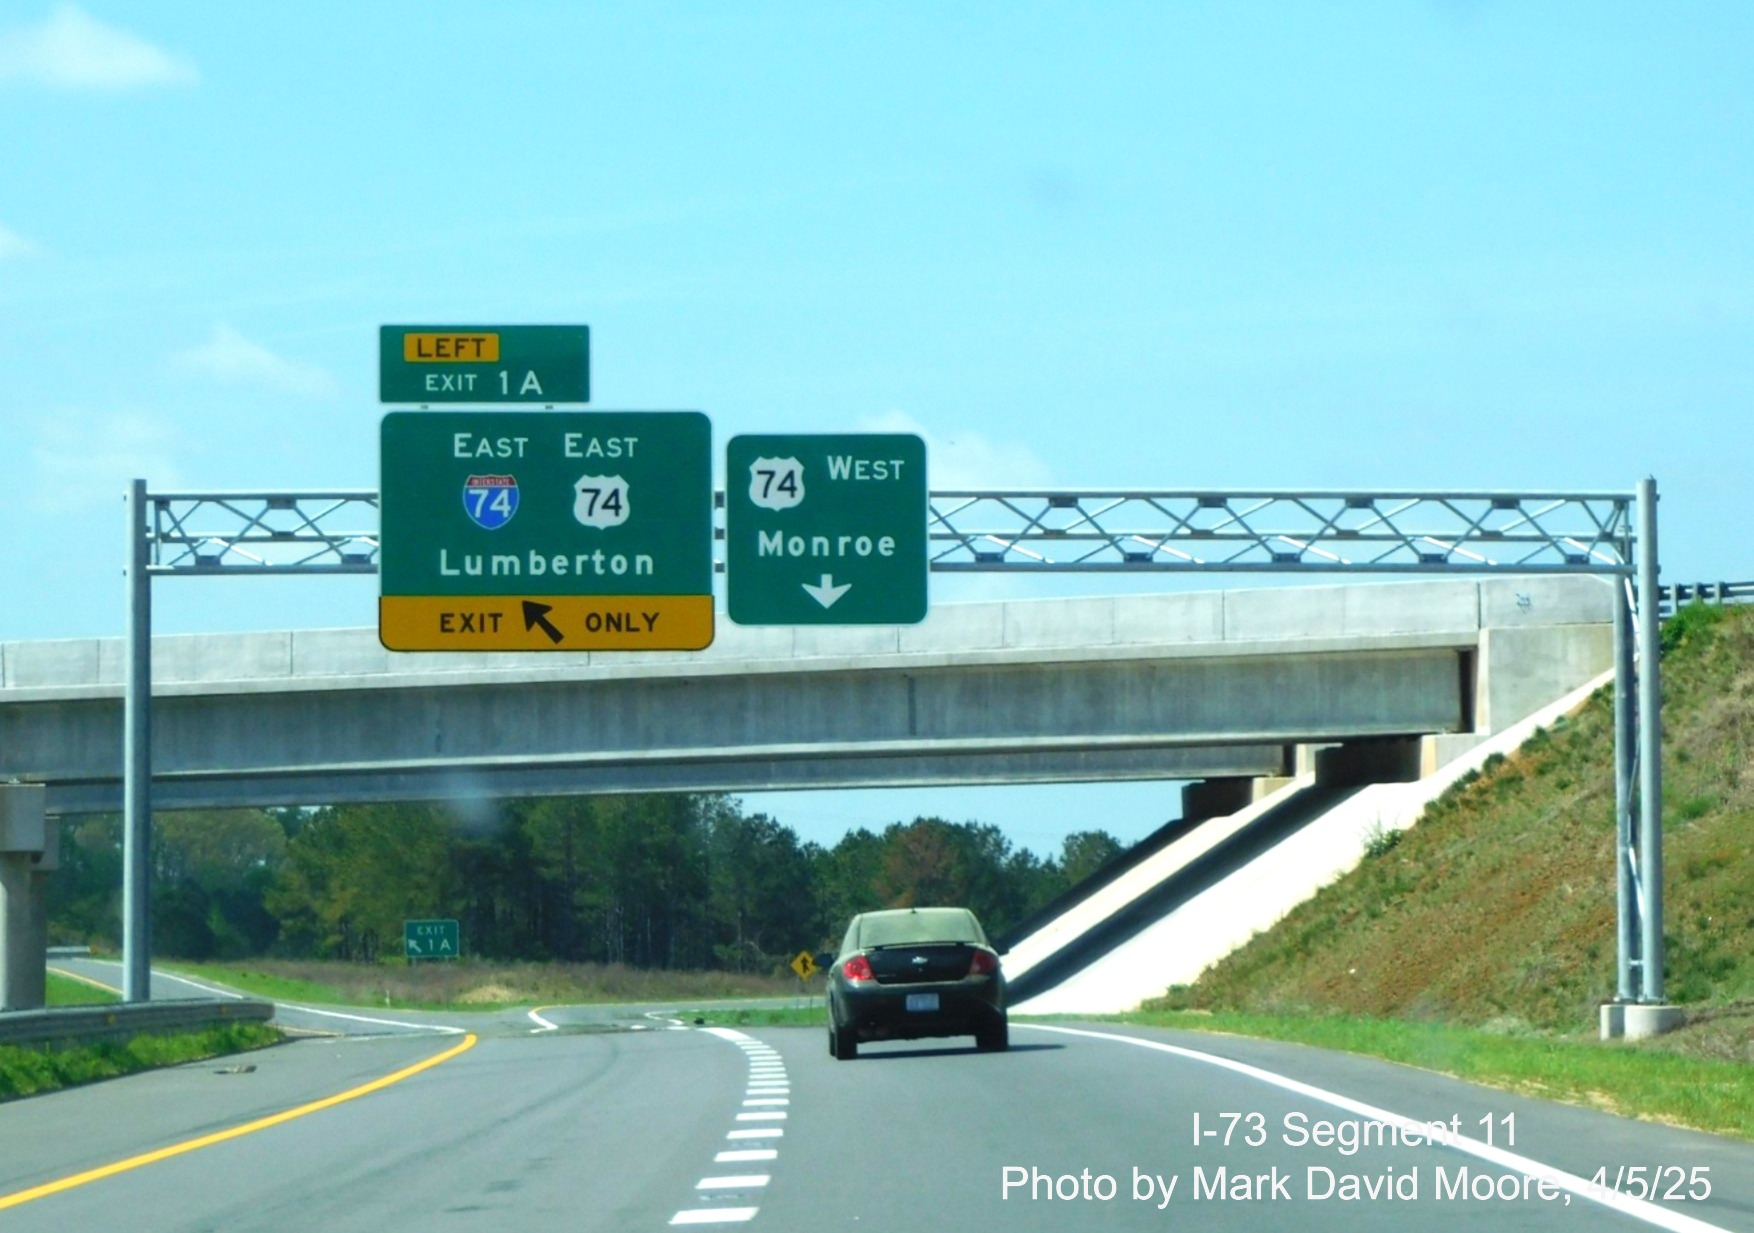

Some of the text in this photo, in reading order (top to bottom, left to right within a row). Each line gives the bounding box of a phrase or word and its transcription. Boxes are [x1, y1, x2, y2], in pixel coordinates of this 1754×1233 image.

[416, 337, 486, 358] LEFT
[425, 373, 478, 392] EXIT
[454, 433, 639, 458] EAST EAST
[471, 478, 511, 486] INTERSTATE
[756, 456, 904, 499] 74 WEST
[468, 489, 511, 518] 74
[581, 488, 622, 517] 74
[758, 531, 896, 557] Monroe
[440, 549, 655, 576] Lumberton
[440, 612, 661, 633] EXIT ONLY
[417, 926, 445, 935] EXIT
